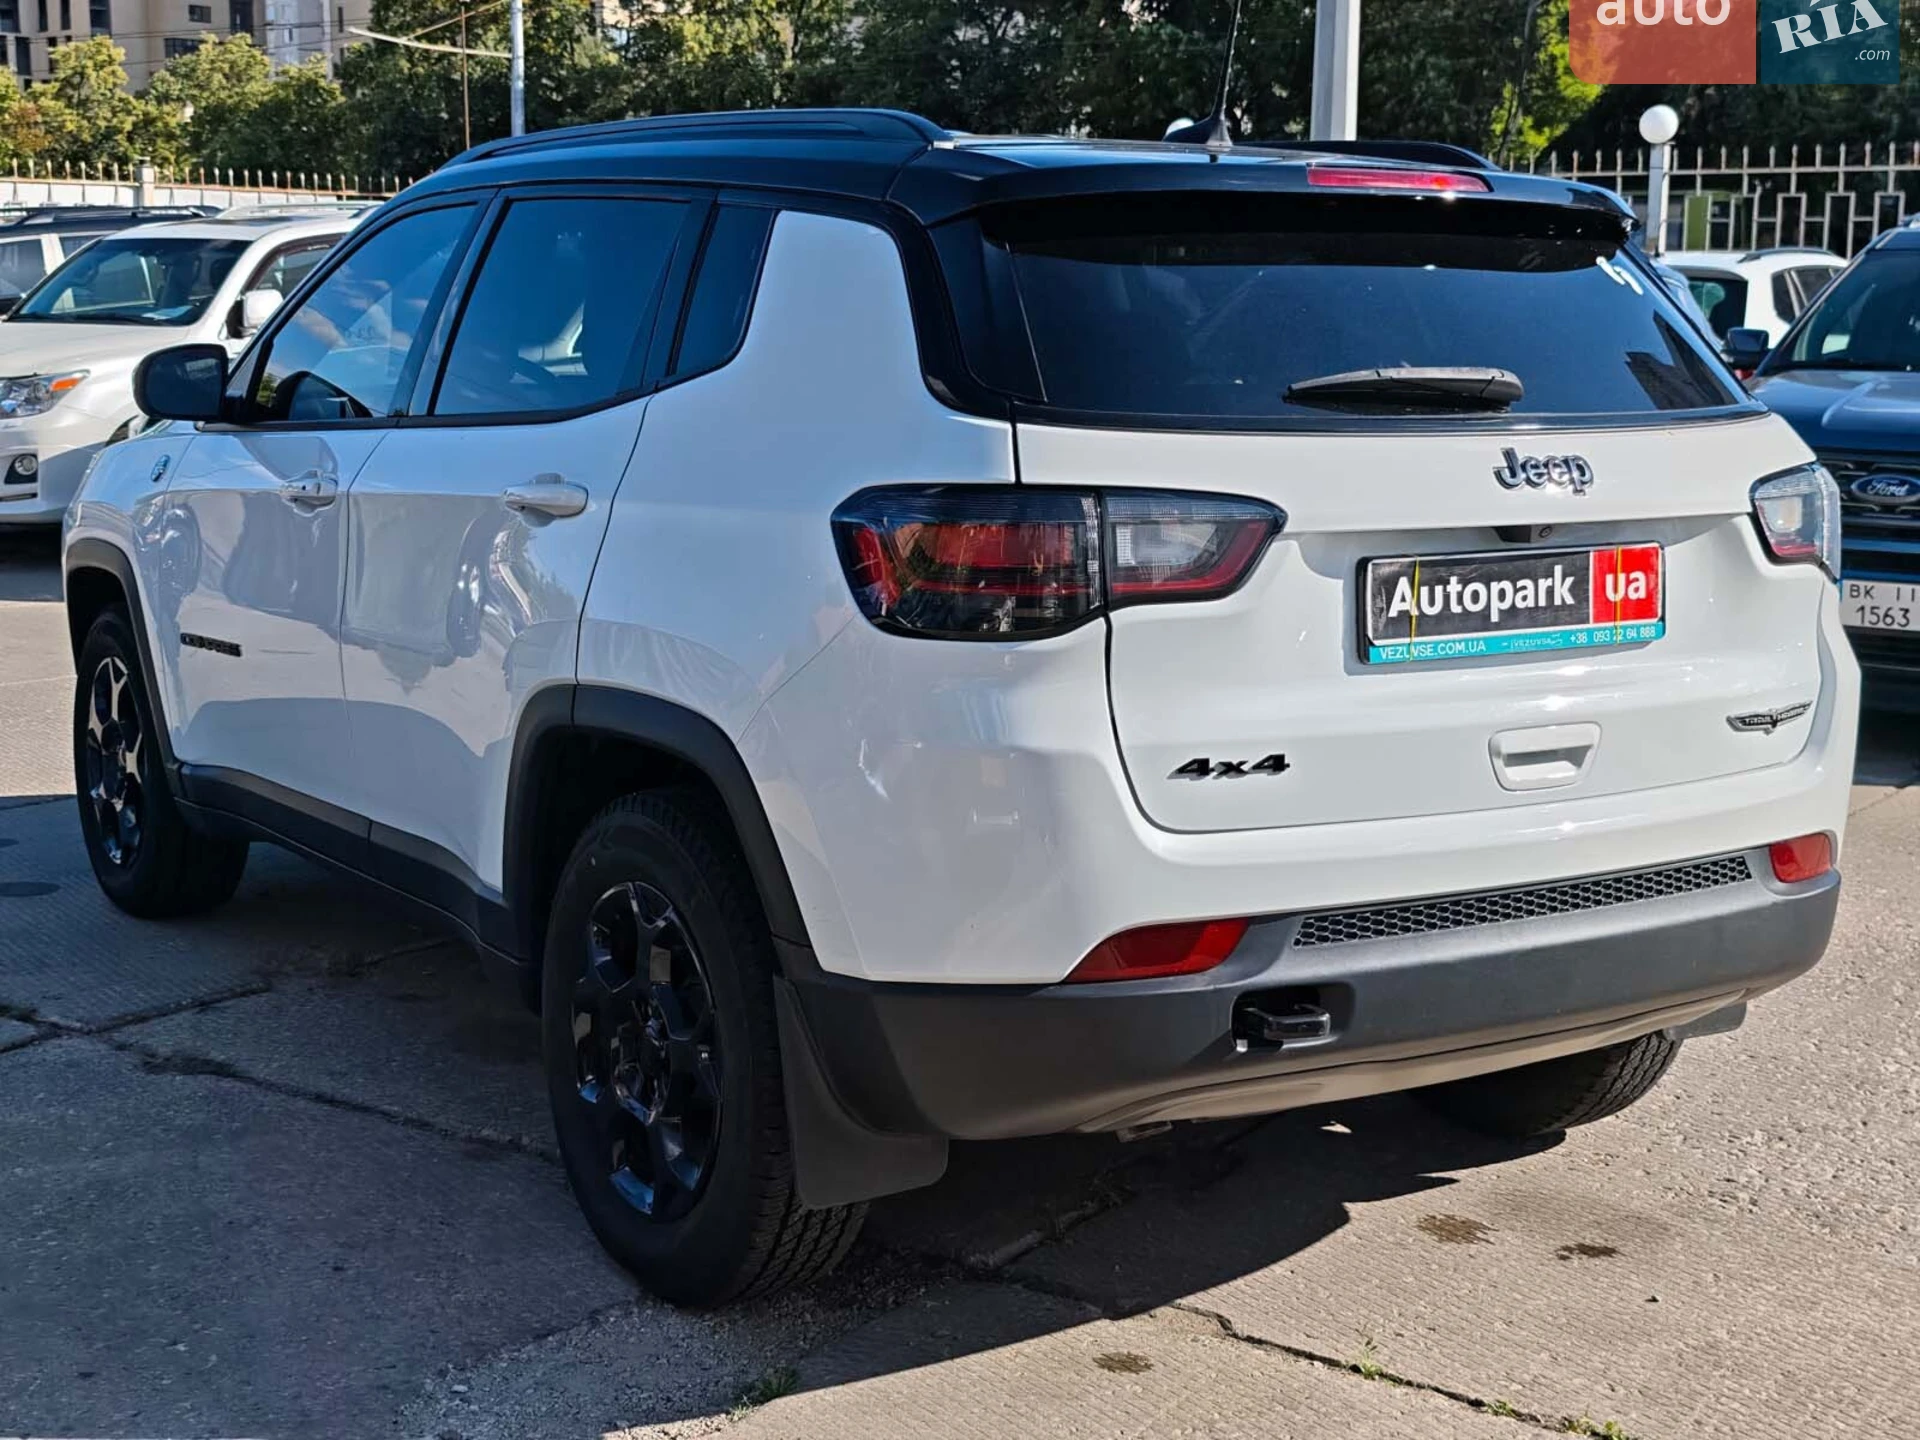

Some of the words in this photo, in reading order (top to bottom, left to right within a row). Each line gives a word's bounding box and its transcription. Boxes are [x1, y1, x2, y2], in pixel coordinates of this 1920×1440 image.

[1492, 447, 1594, 496] Jeep
[1867, 480, 1910, 496] Ford
[1388, 565, 1575, 622] Autopark
[1605, 570, 1647, 602] ua
[1849, 584, 1875, 600] BK
[1855, 605, 1911, 627] 1563
[1379, 640, 1487, 660] VEZUVSE.COM.UA
[1167, 753, 1290, 781] 4x4
